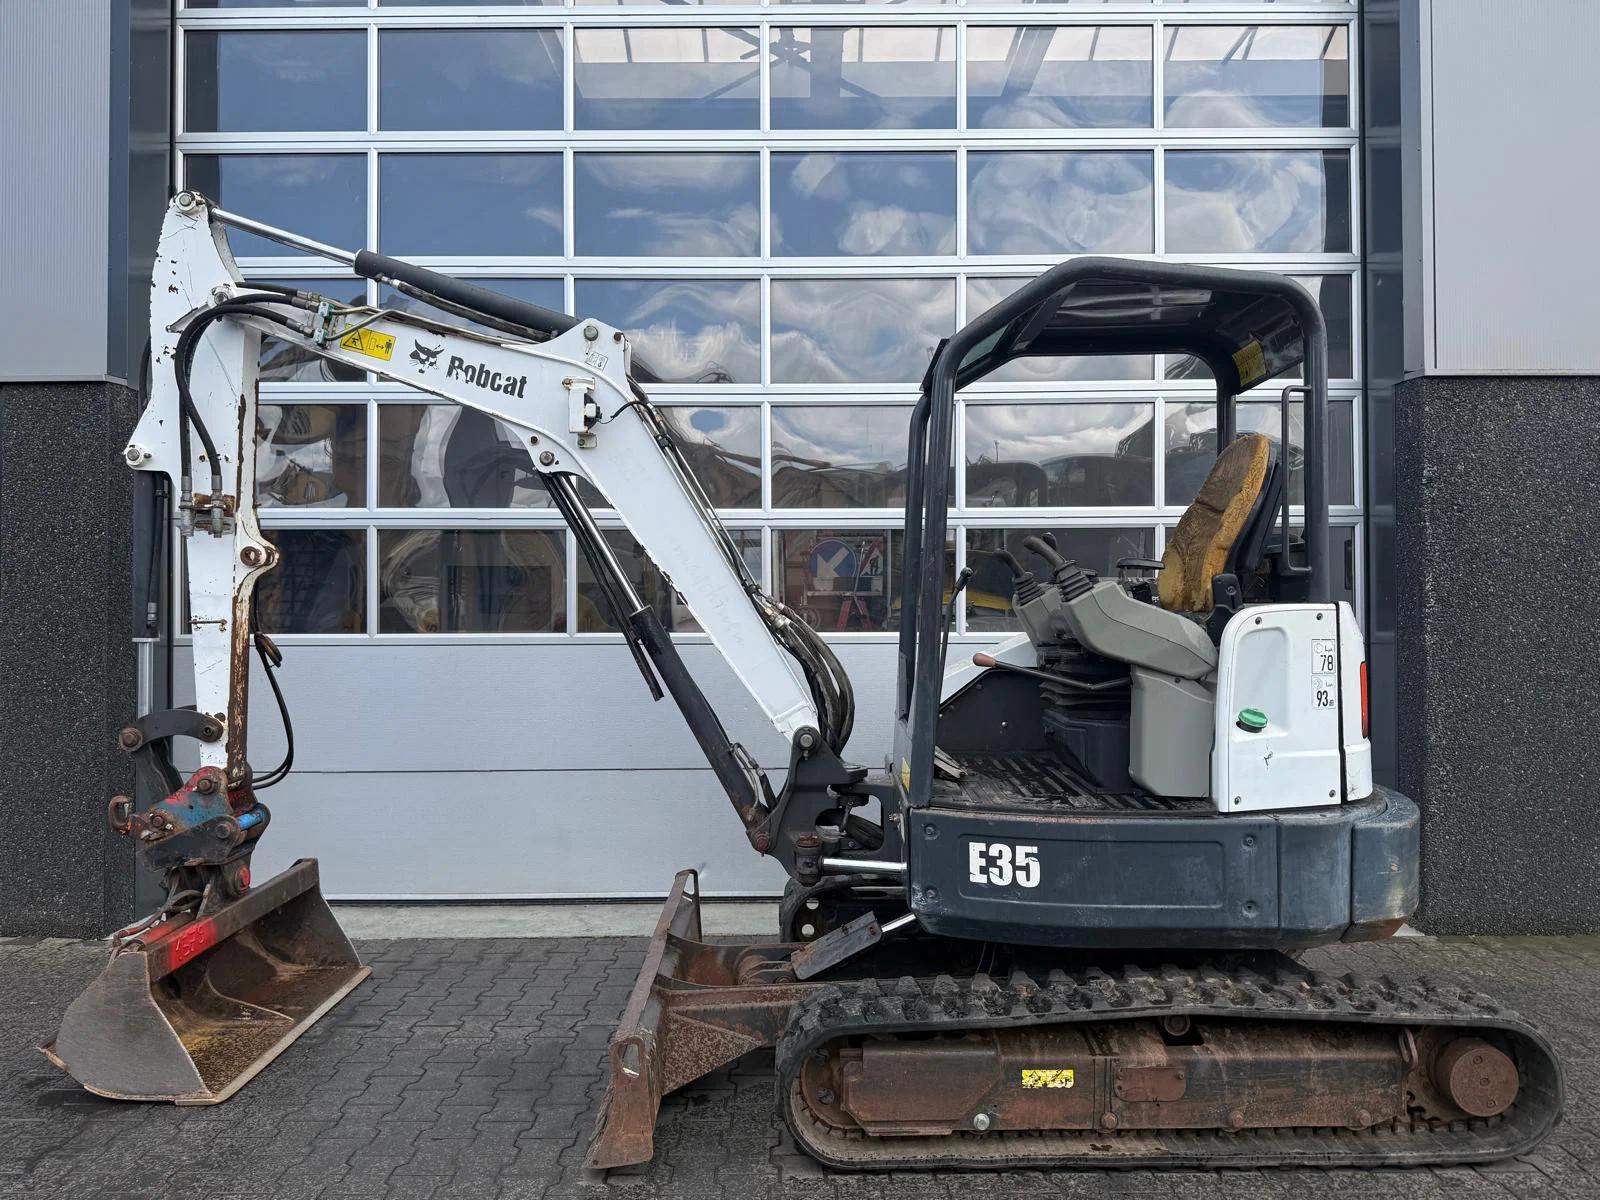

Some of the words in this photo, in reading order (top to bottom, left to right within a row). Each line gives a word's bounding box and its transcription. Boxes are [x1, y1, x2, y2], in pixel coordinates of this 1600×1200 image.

[1320, 655, 1334, 671] 78
[1316, 690, 1328, 707] 93
[968, 842, 1041, 888] E35
